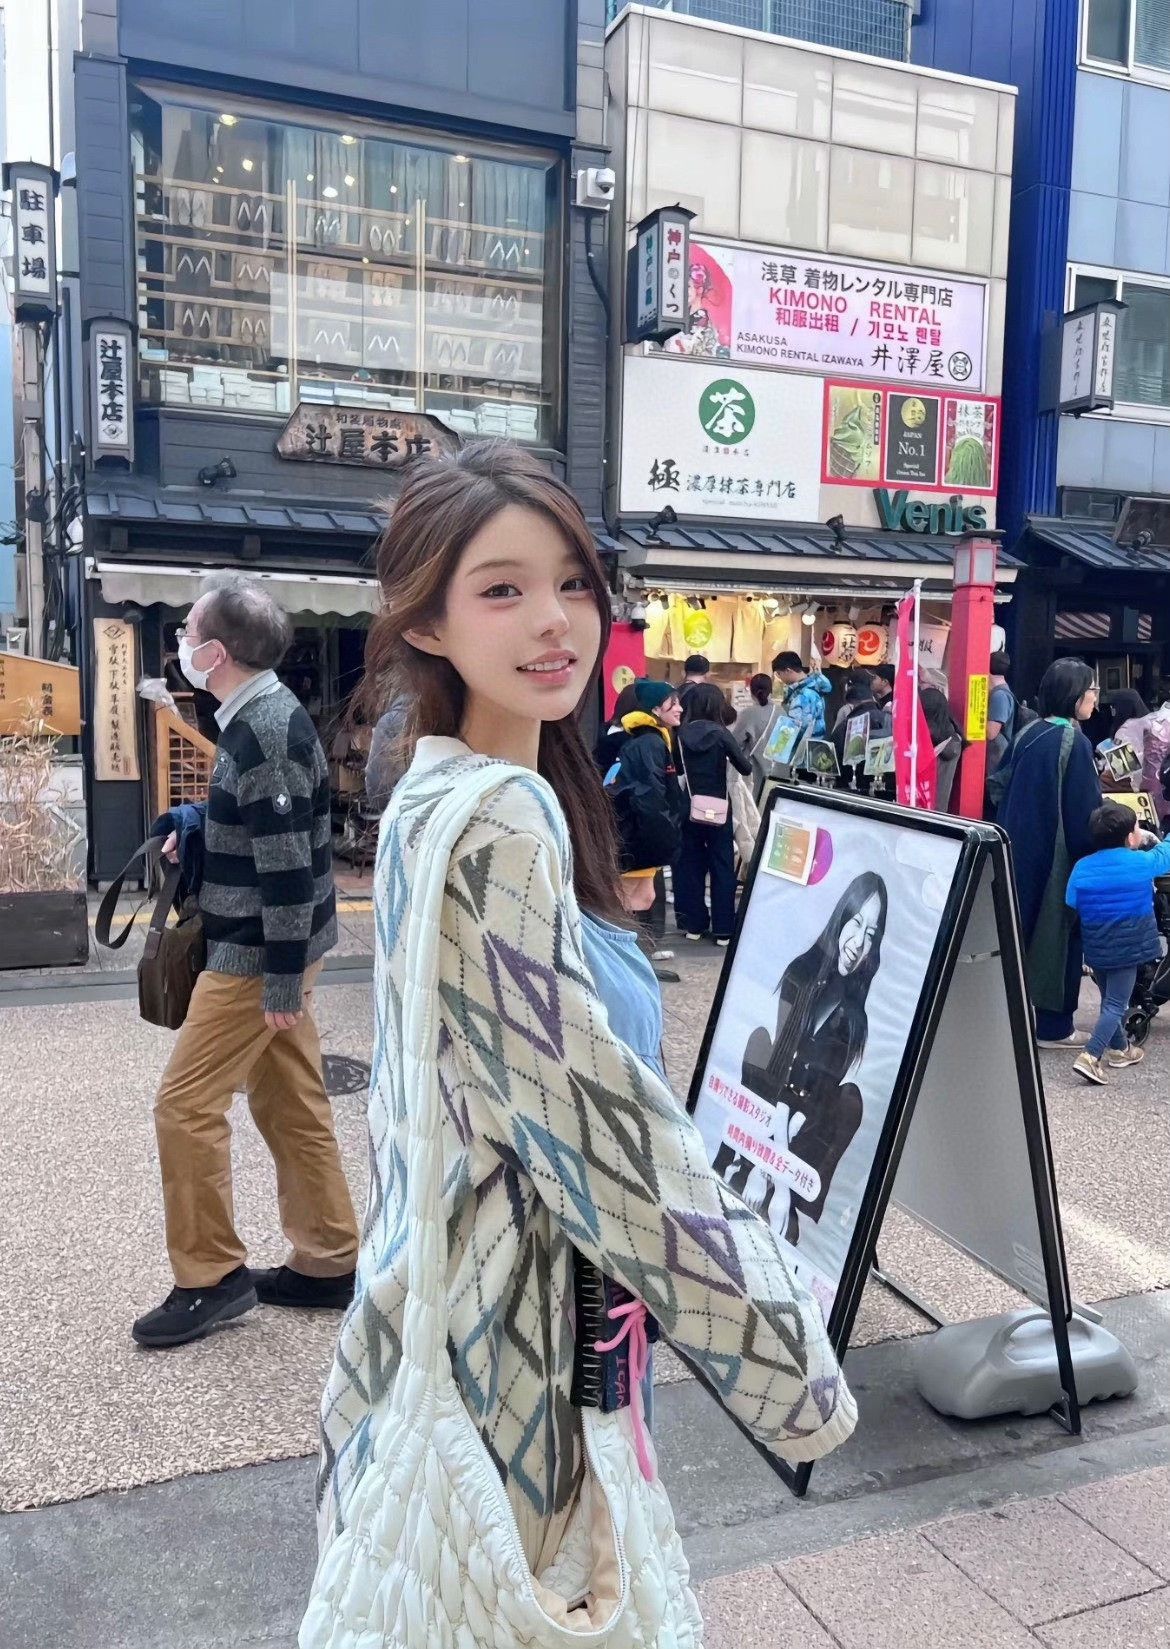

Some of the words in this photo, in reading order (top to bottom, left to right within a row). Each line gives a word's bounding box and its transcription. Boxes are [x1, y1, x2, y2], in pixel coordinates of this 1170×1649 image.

[19, 189, 47, 280] 駐車場
[666, 228, 682, 313] 神戸のくつ
[761, 261, 798, 286] 浅草
[804, 268, 954, 308] 着物レンタル専門店
[769, 287, 848, 313] KIMONO
[870, 301, 942, 326] RENTAL
[737, 331, 788, 346] ASAKUSA
[776, 308, 840, 333] 和服出租
[868, 320, 909, 343] 기모노
[916, 326, 942, 347] 렌탈
[736, 344, 778, 357] KIMONO
[780, 349, 819, 363] RENTAL
[821, 354, 865, 368] IZAWAYA
[870, 343, 945, 379] 井澤屋
[100, 338, 125, 423] 辻屋本店
[704, 386, 747, 438] 茶
[898, 441, 926, 457] No.1
[647, 457, 681, 493] 極
[687, 473, 797, 500] 濃厚抹茶専門店
[872, 488, 987, 536] Venis
